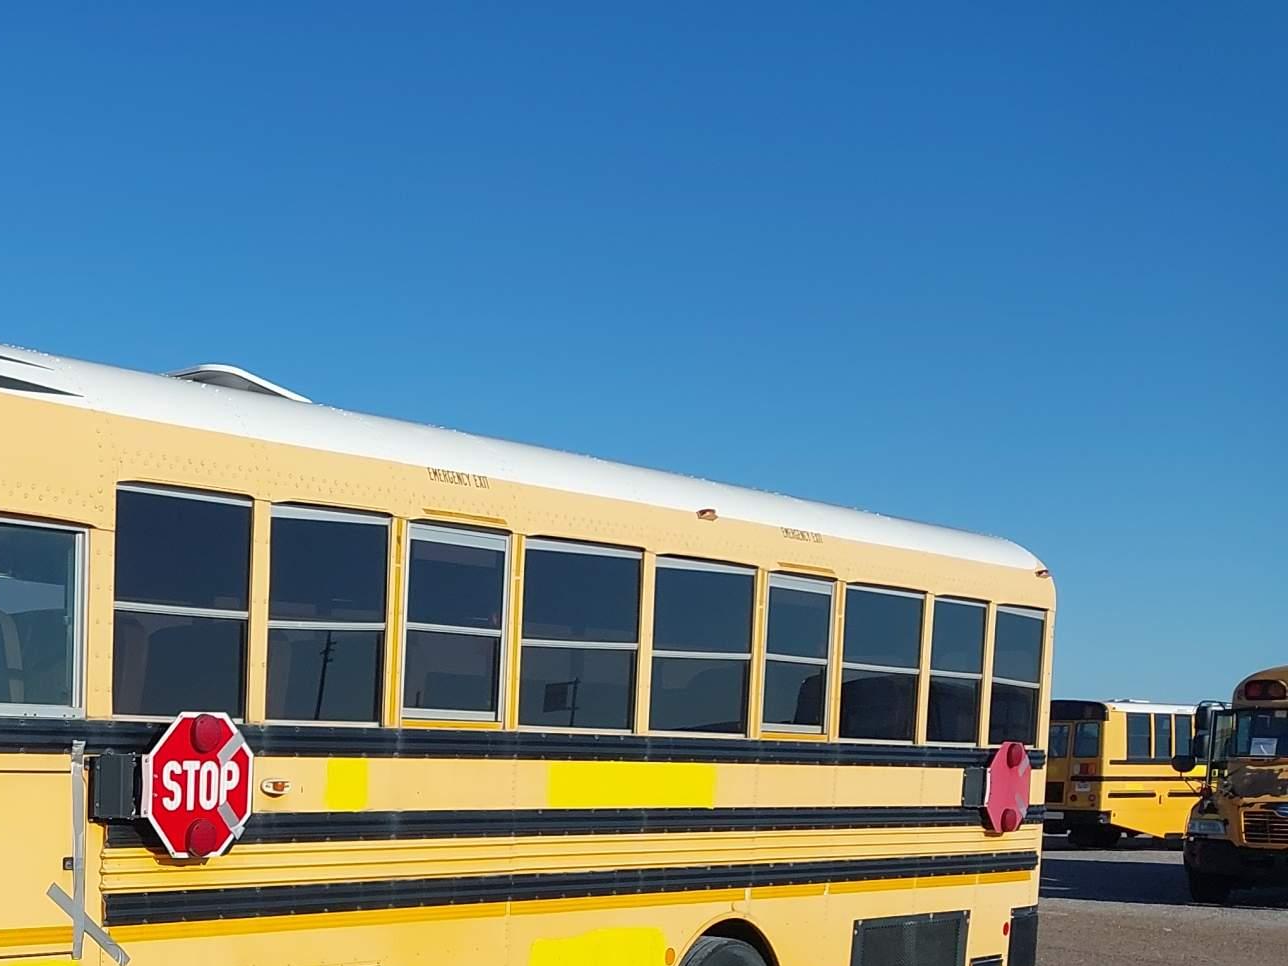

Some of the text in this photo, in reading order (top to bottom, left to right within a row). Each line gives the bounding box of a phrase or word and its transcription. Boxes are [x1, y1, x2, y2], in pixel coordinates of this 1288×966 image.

[427, 467, 490, 489] EMERGENCY EXIT
[161, 759, 241, 812] STOP
